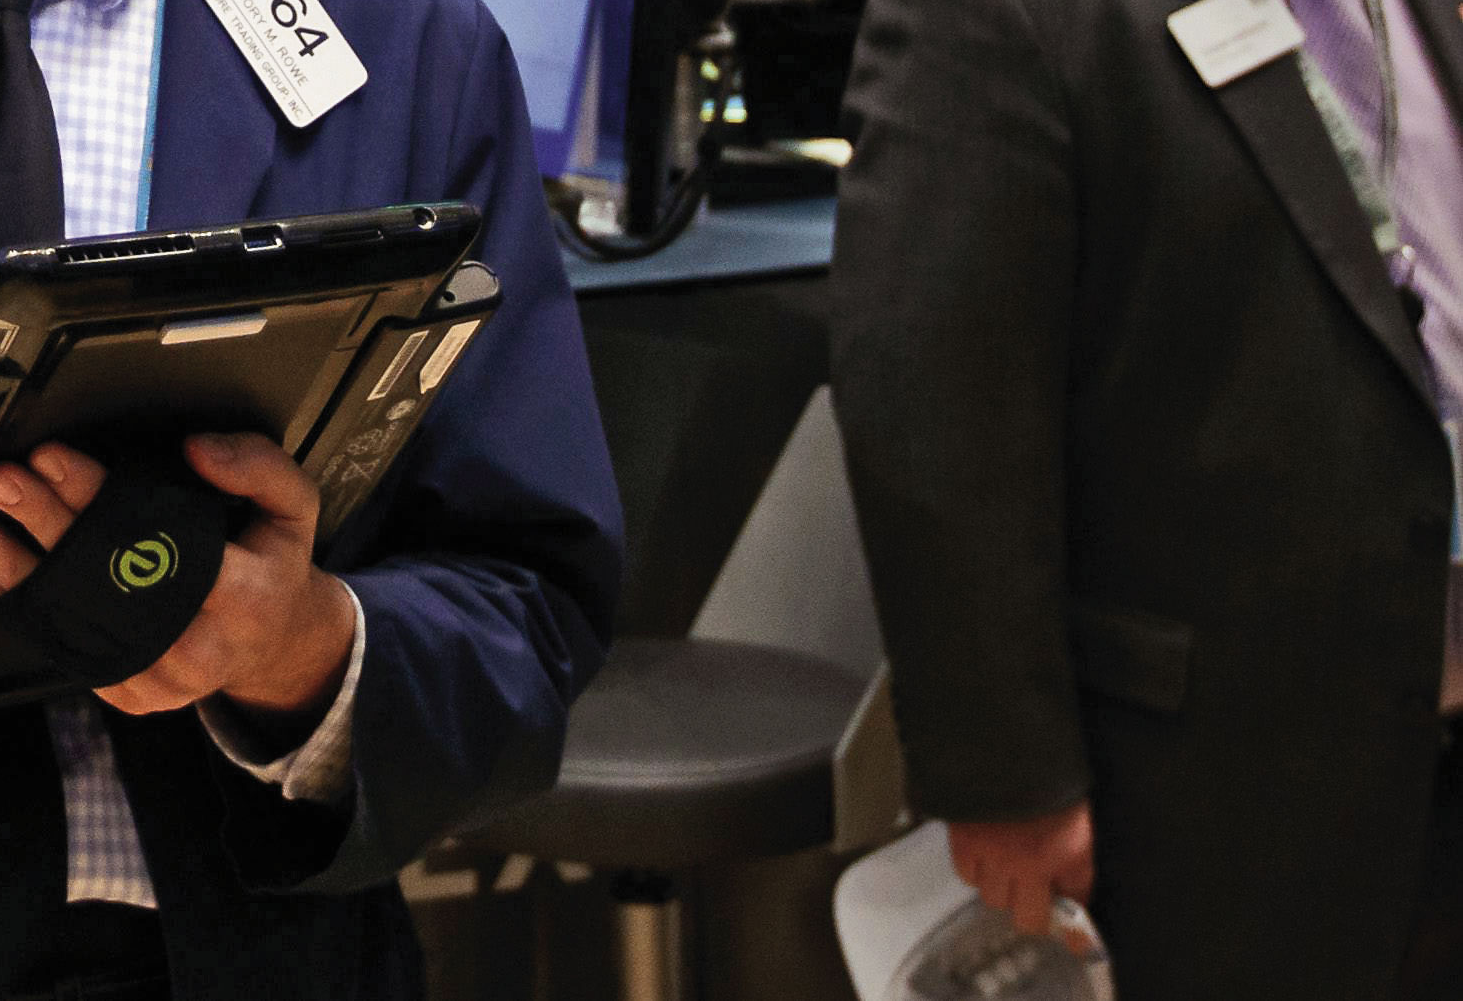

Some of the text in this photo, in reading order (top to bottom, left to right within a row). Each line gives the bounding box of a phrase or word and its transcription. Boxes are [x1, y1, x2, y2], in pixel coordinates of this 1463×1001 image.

[231, 16, 264, 60] TRADING
[264, 28, 279, 46] M.
[277, 46, 308, 87] ROWE
